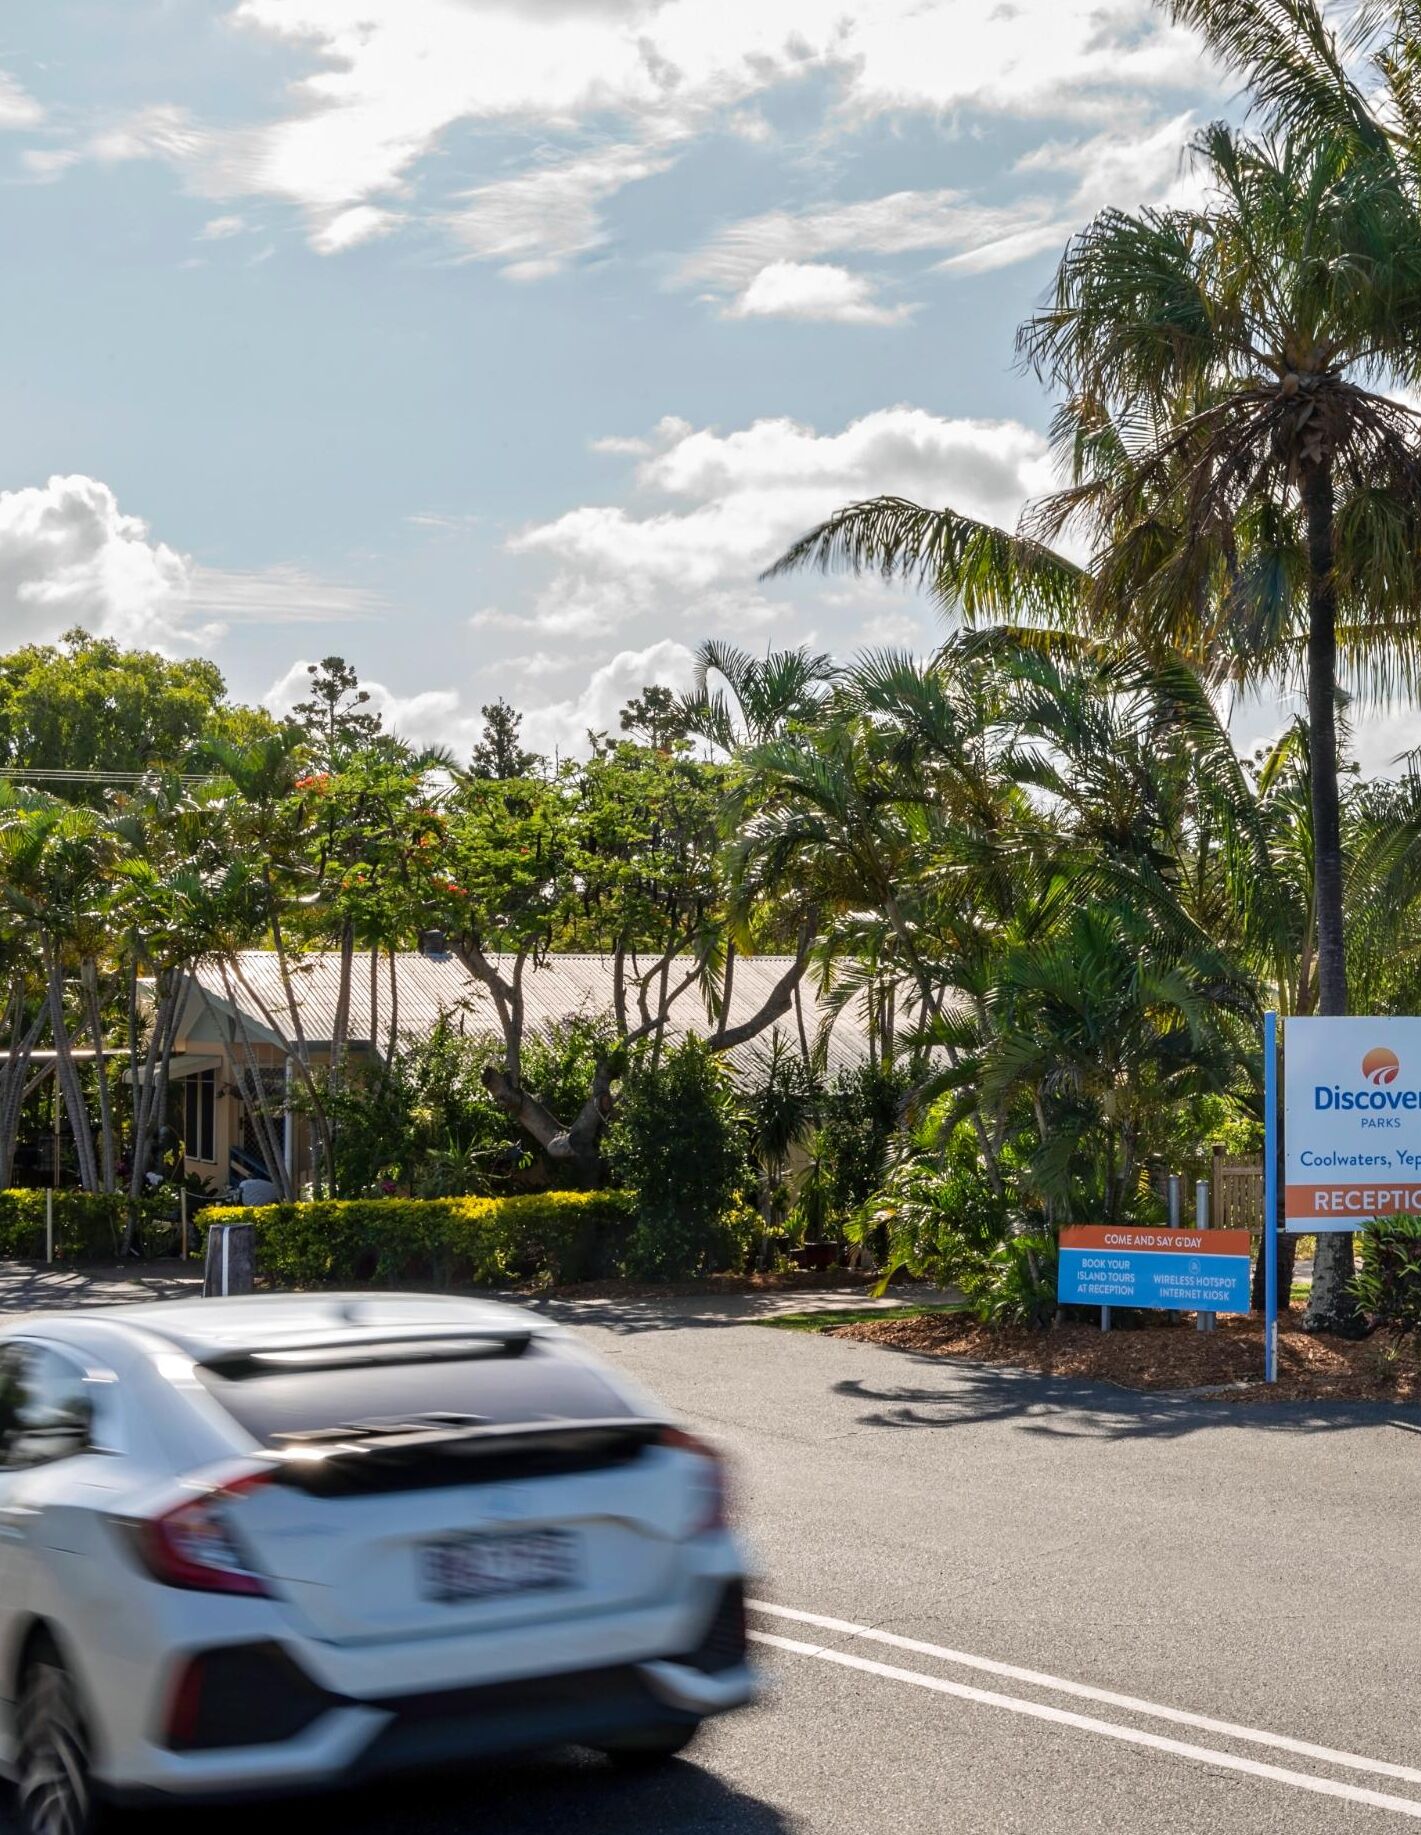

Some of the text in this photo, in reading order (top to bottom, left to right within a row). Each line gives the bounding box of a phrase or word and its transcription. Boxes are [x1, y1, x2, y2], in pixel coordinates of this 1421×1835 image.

[1361, 1117, 1401, 1129] PARKS
[1300, 1150, 1392, 1169] Coolwaters,
[1104, 1233, 1132, 1245] COME
[1133, 1235, 1155, 1246] AND
[1156, 1235, 1174, 1247] SAY
[1081, 1258, 1131, 1270] BOOK YOUR
[1077, 1271, 1136, 1283] ISLAND TOURS
[1153, 1274, 1237, 1288] WIRELESS HOTSPOT
[1076, 1284, 1135, 1296] AT RECEPTION
[1159, 1288, 1230, 1301] INTERNET KIOSK
